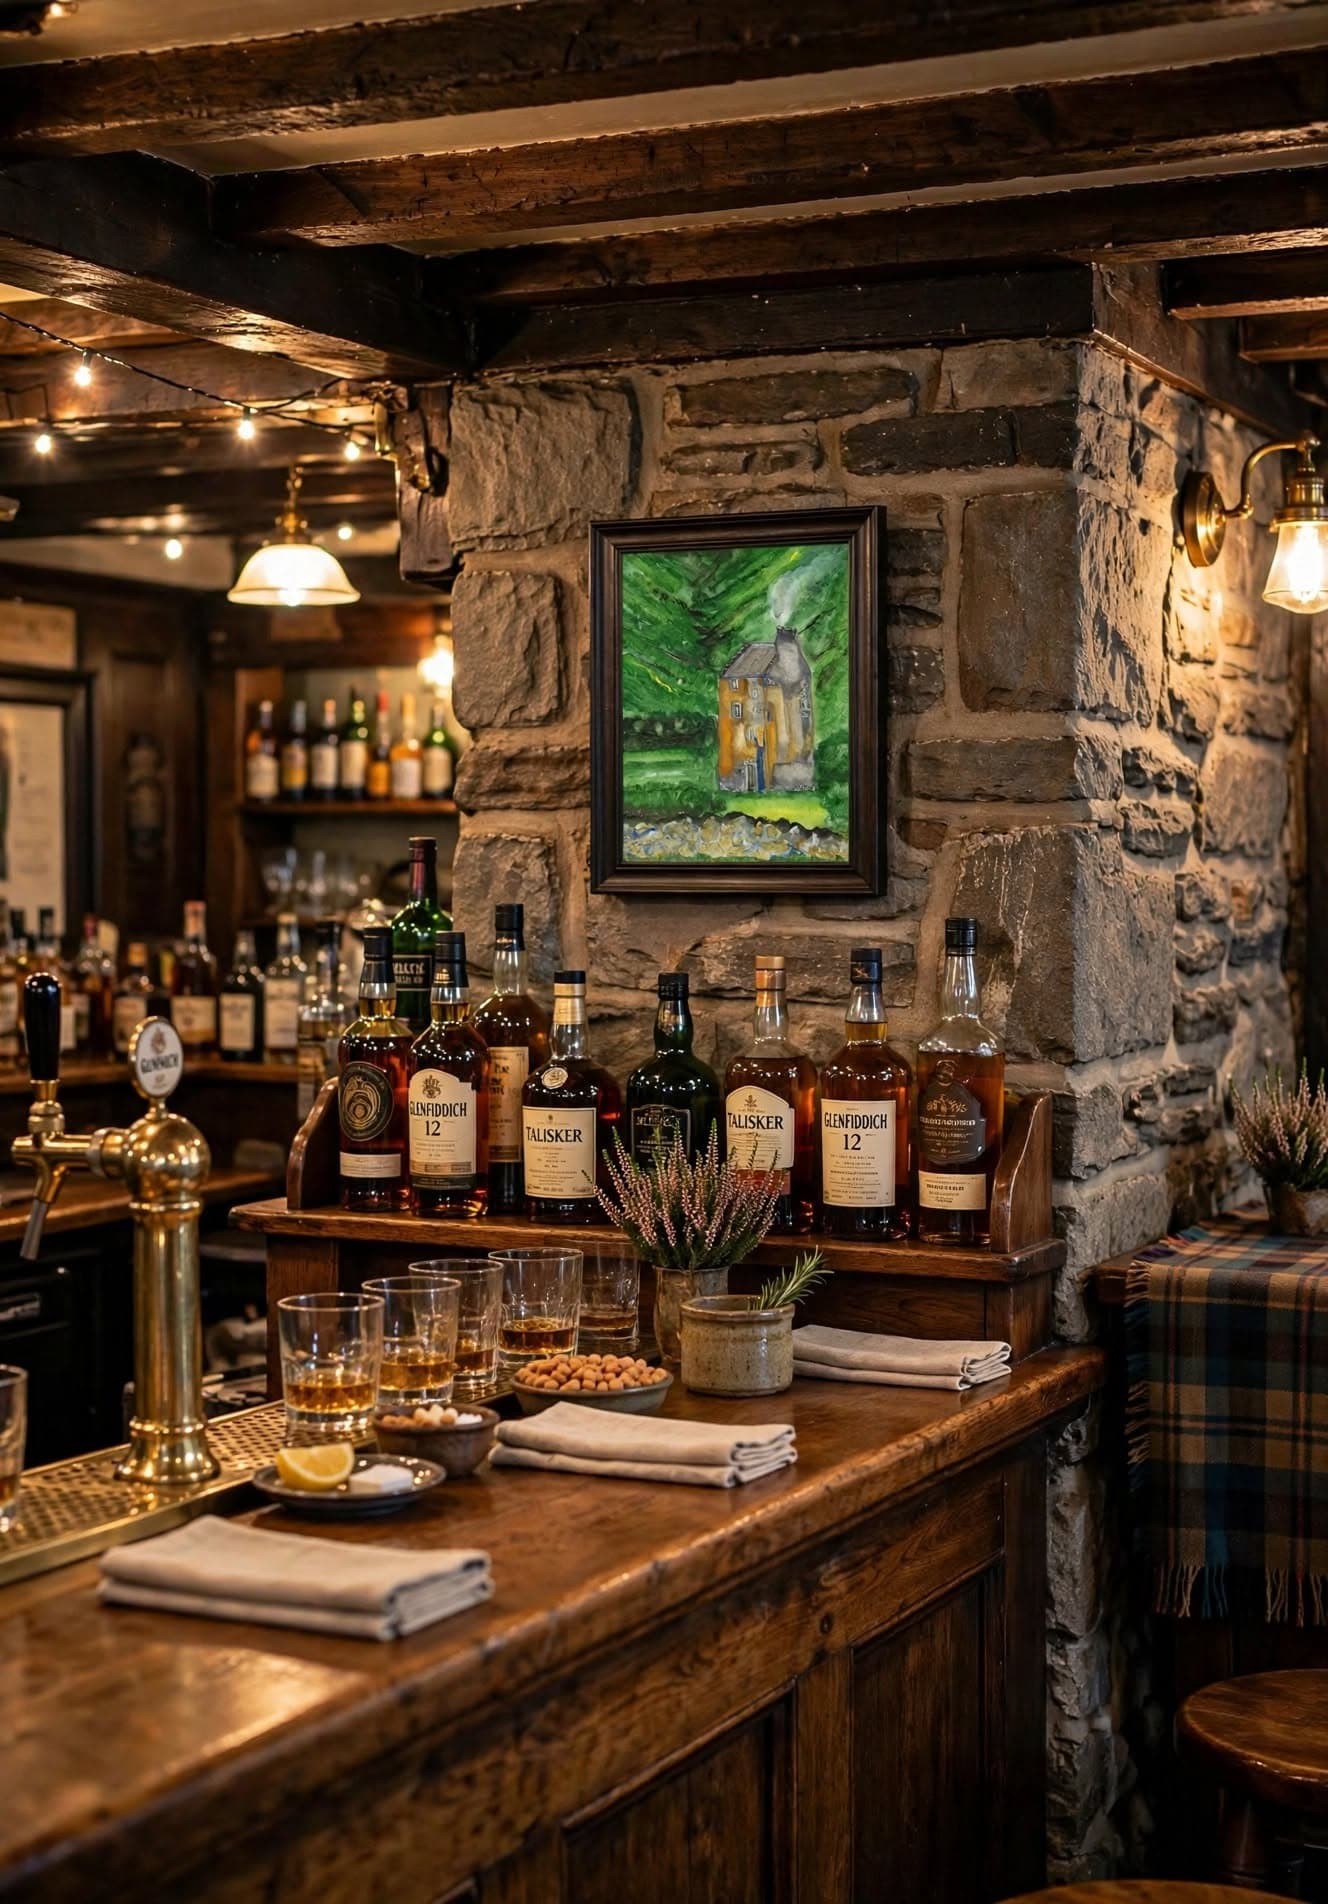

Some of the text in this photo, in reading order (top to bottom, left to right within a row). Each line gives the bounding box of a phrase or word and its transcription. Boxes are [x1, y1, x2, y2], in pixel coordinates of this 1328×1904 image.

[410, 1101, 467, 1118] GLENFIDDICH
[425, 1120, 441, 1137] 12
[727, 1112, 784, 1130] TALISKER
[824, 1112, 887, 1130] GLENFIDDICH
[526, 1126, 583, 1143] TALISKER
[843, 1133, 861, 1151] 12
